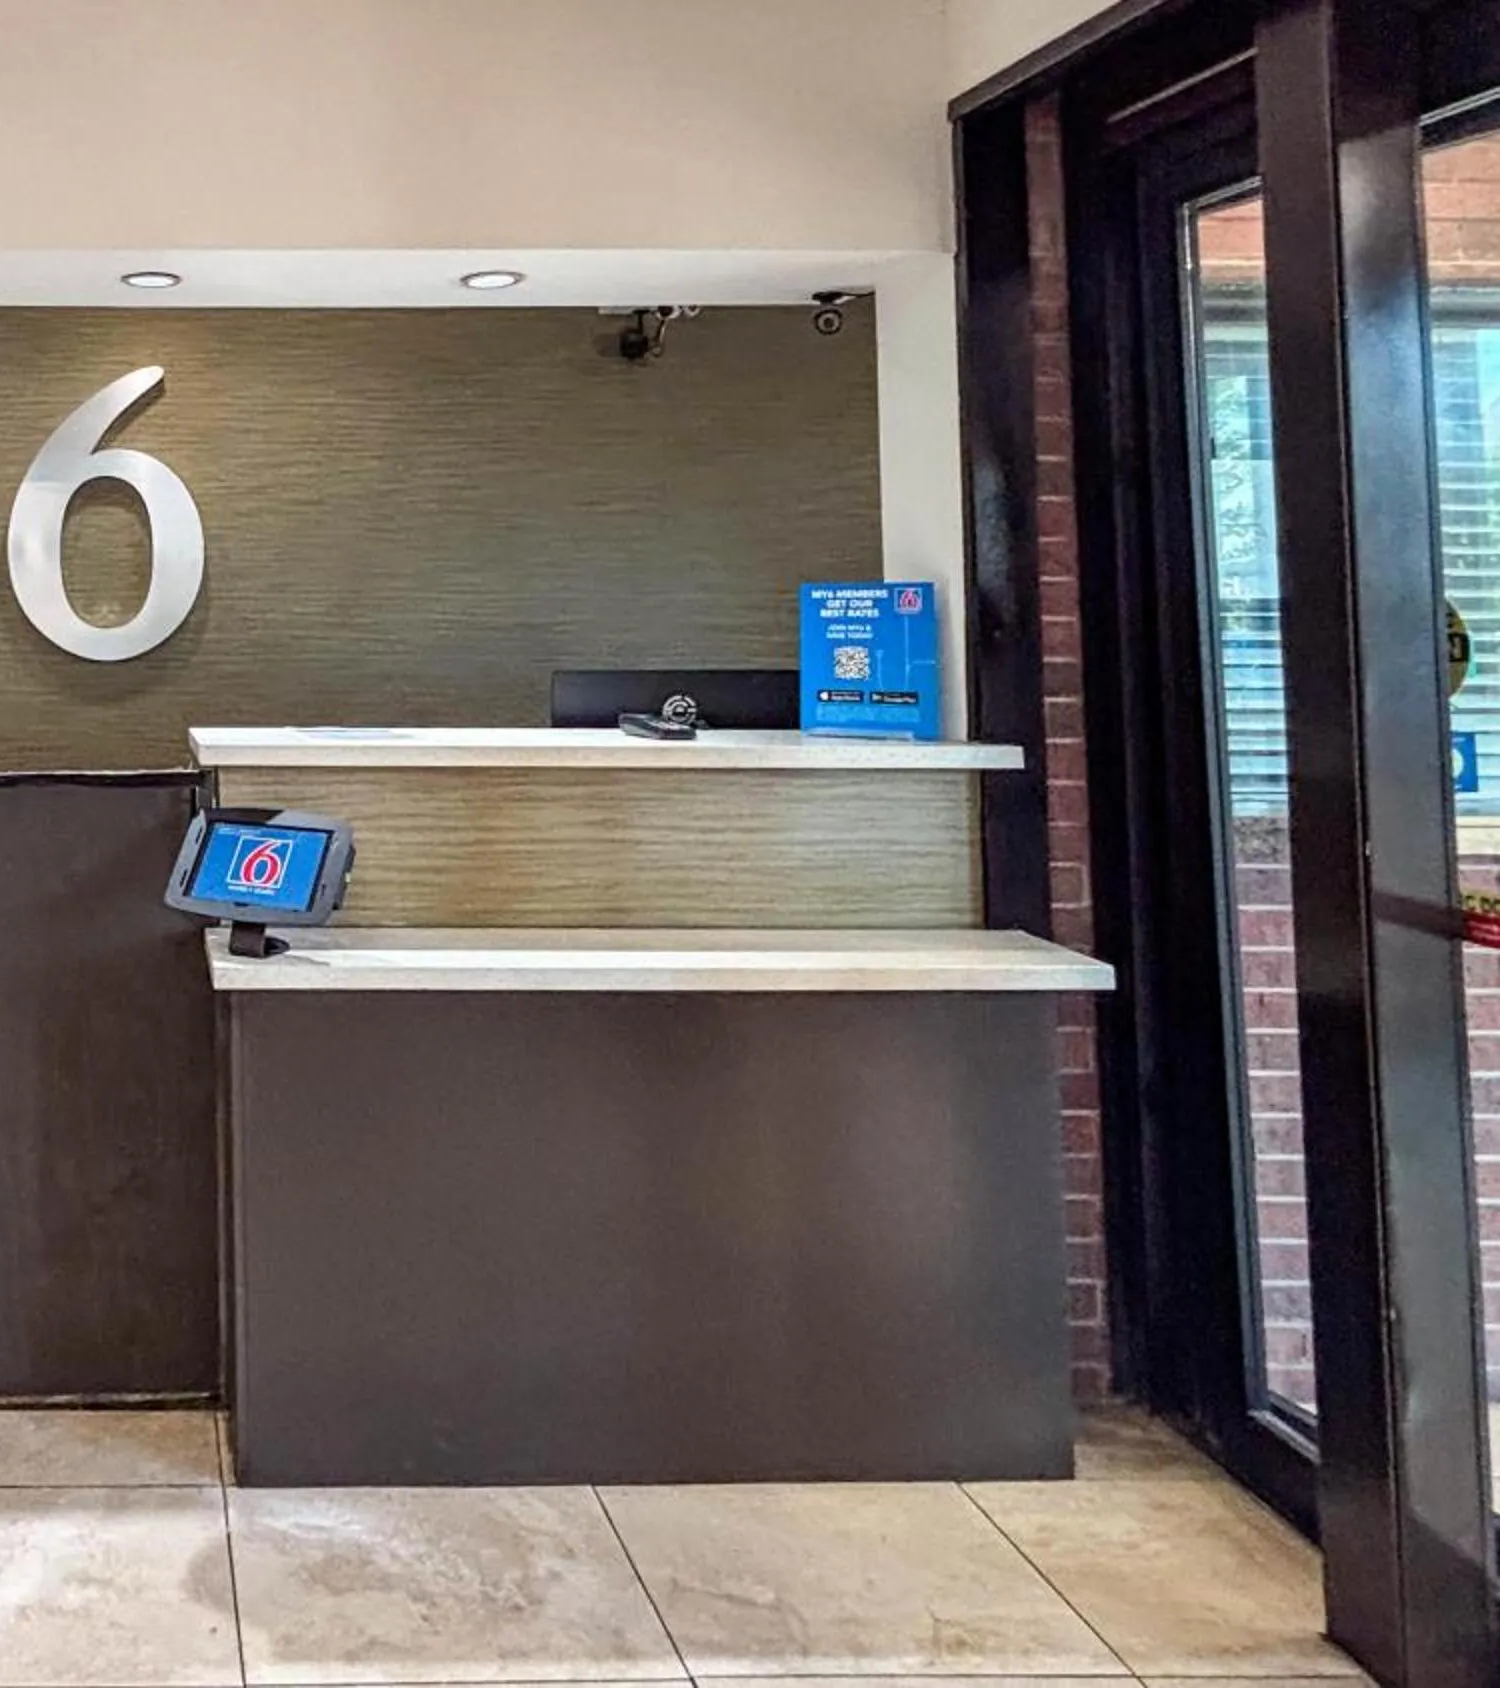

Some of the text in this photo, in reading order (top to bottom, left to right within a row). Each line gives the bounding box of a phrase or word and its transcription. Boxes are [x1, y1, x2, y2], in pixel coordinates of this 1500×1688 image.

[7, 366, 204, 662] 6
[835, 589, 888, 599] MEMBERS
[826, 599, 873, 609] GET OUR
[846, 608, 879, 618] RATES
[241, 839, 281, 886] 6
